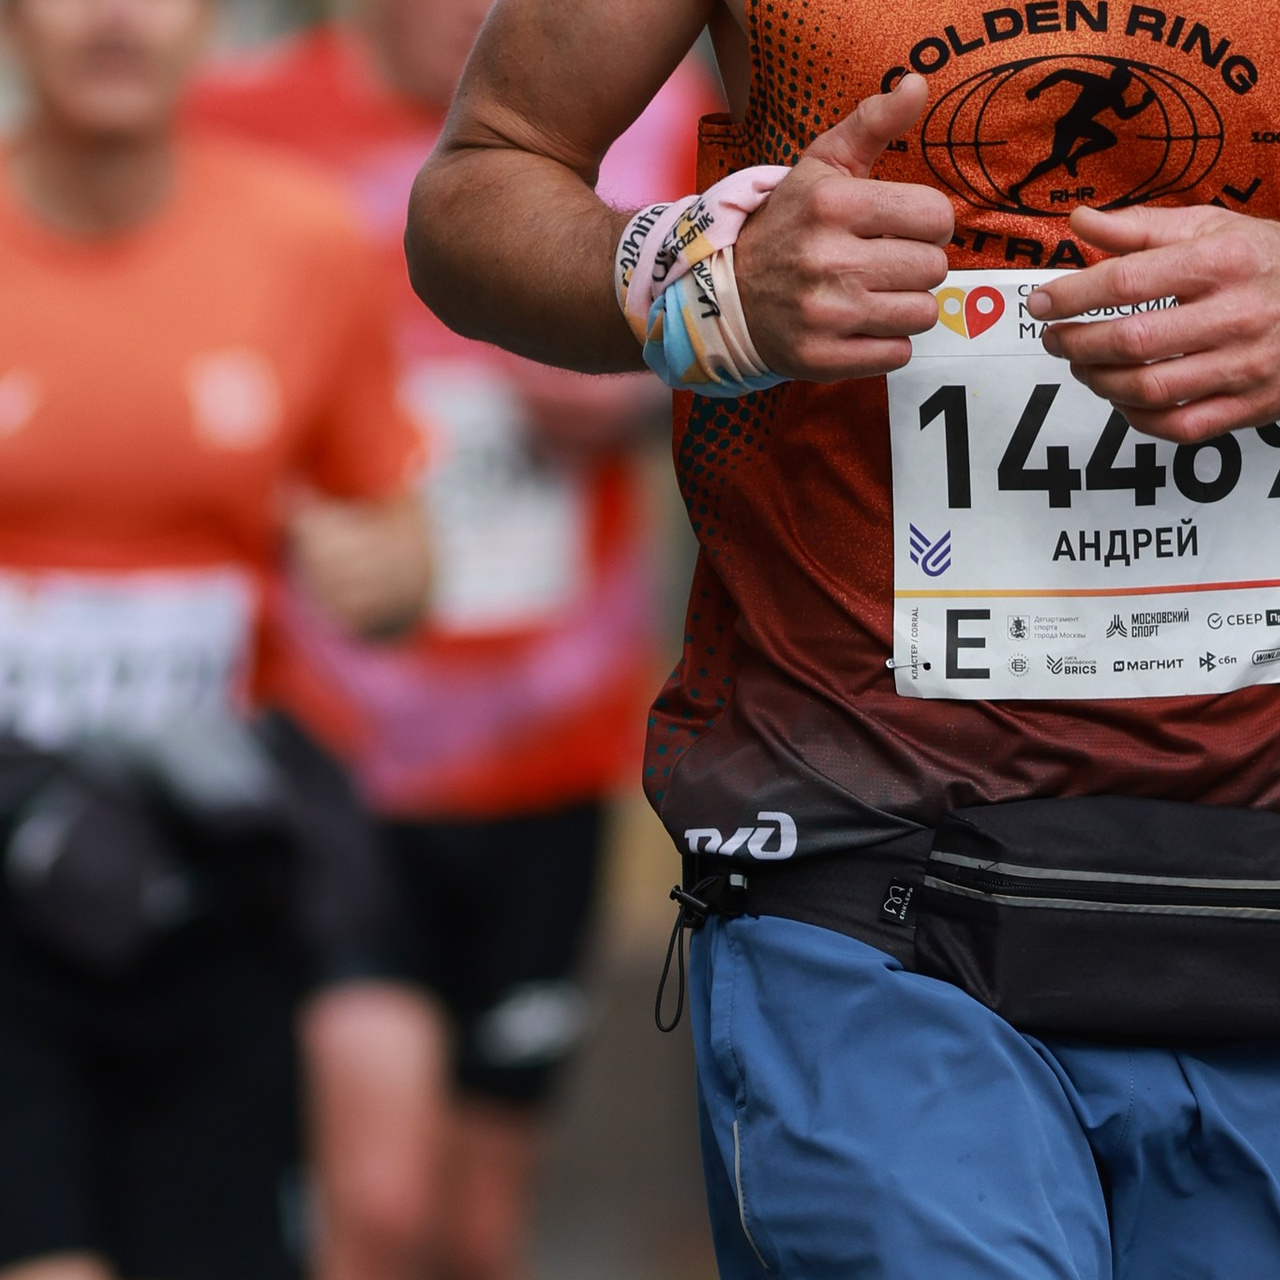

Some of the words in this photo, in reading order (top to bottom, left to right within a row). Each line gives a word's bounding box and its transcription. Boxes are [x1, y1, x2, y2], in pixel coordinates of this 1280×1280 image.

[881, 0, 1108, 94] GOLDEN
[1126, 5, 1258, 96] RING
[1049, 186, 1096, 204] RHR
[952, 227, 1088, 268] TRA
[1052, 518, 1198, 567] АНДРЕЙ
[911, 606, 919, 638] CORRAL
[1131, 608, 1190, 625] МОСКОВСКИЙ
[1131, 624, 1160, 638] СПОРТ
[1226, 613, 1263, 626] СБЕР
[946, 609, 990, 679] E
[910, 644, 919, 680] КЛАСТЕР
[1064, 665, 1097, 675] BRICS
